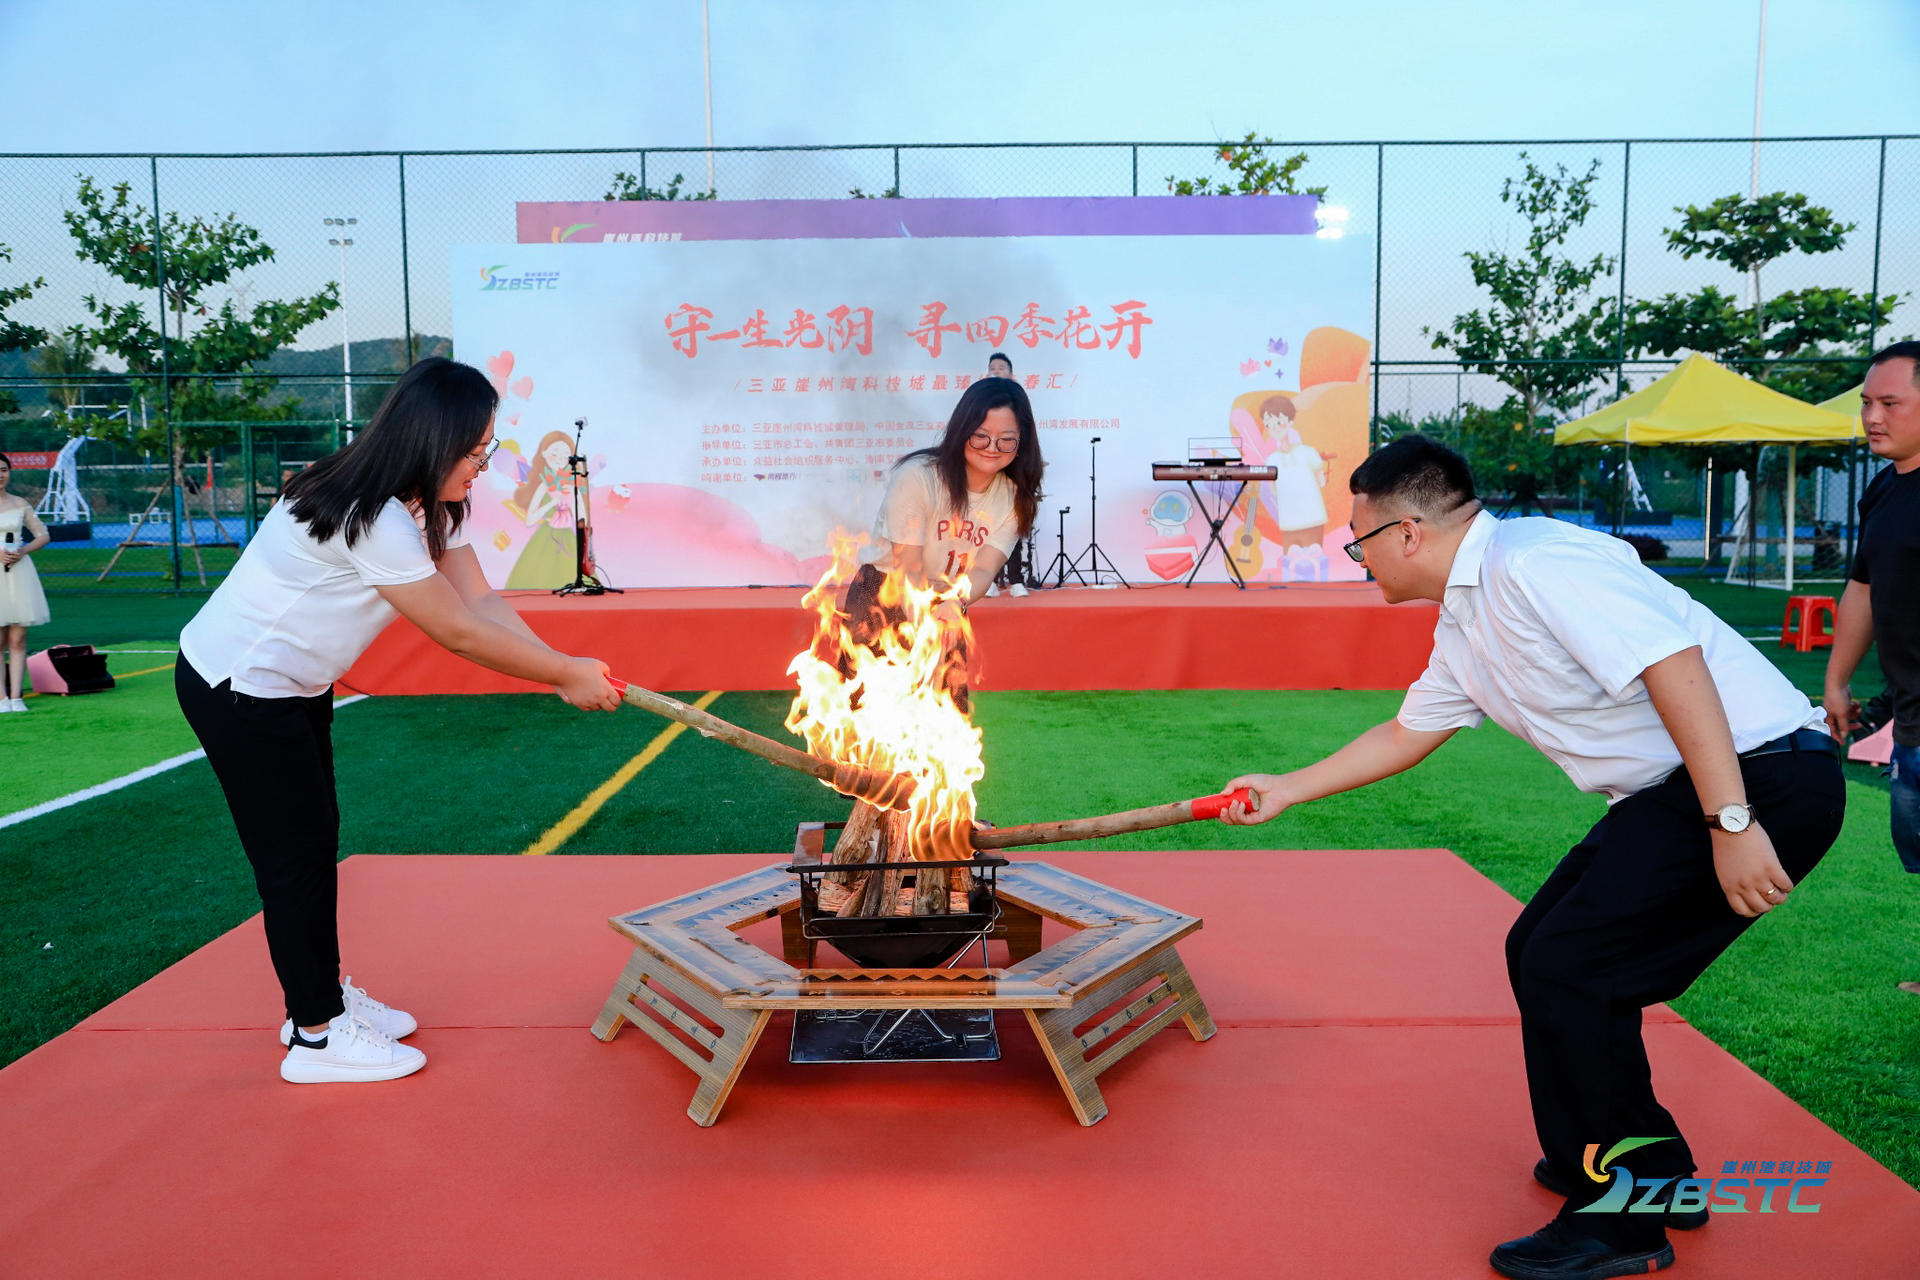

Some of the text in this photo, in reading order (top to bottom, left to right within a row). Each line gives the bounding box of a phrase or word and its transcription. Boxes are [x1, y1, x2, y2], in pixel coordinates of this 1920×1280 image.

[664, 300, 1154, 360] 守一生光阴 寻四季花开
